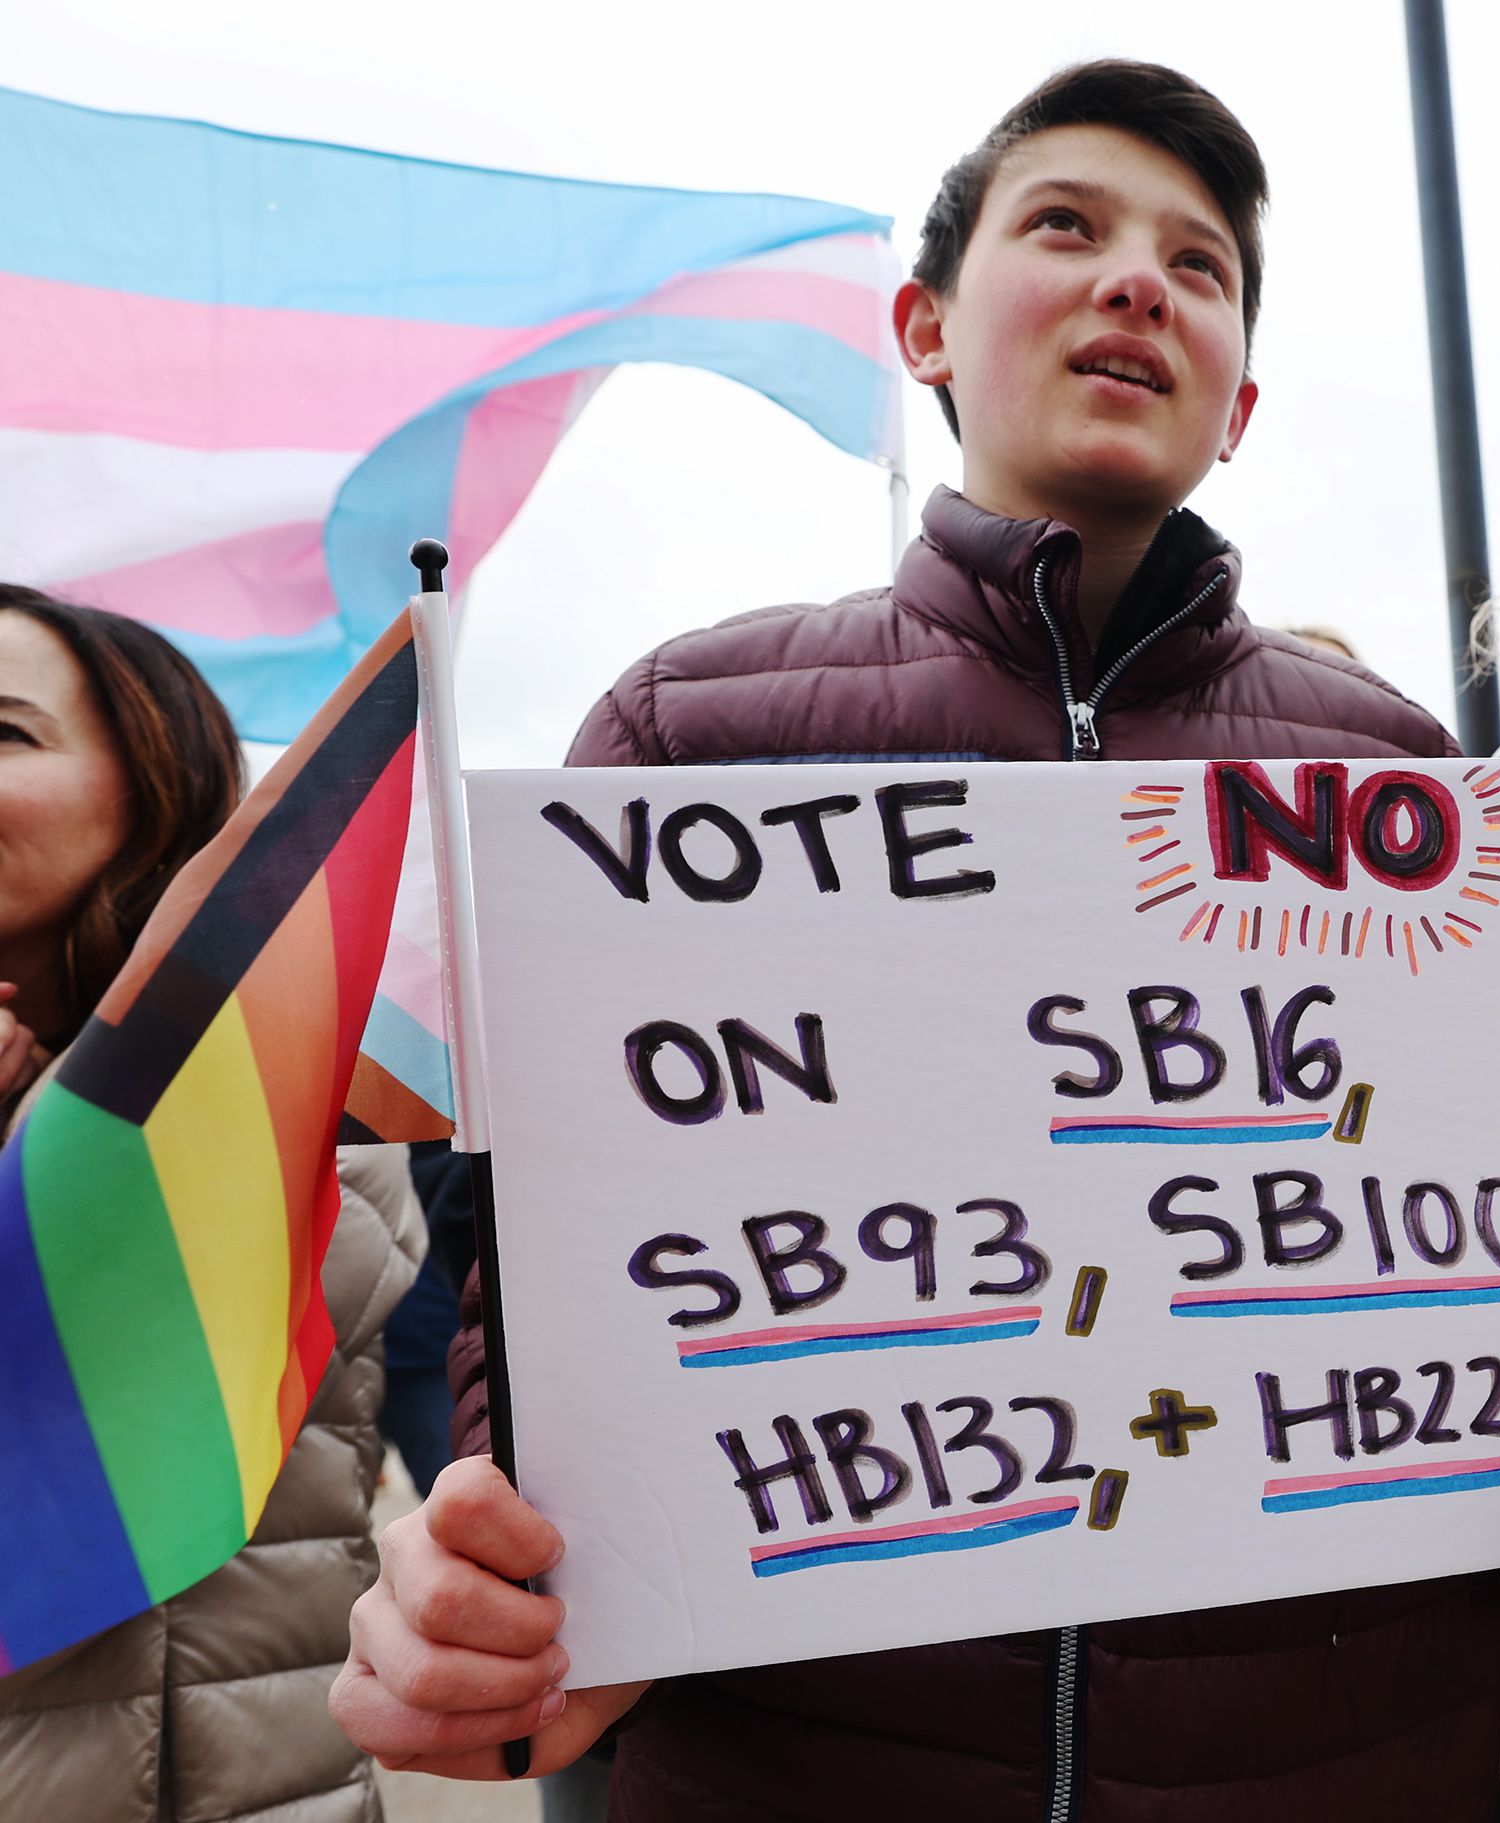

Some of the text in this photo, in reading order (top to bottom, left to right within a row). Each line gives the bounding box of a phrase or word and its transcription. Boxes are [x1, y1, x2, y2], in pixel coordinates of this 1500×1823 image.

[540, 761, 1462, 902] VOTE NO
[623, 983, 1375, 1145] ON SB16,
[627, 1196, 1108, 1338] SB93,
[715, 1395, 1130, 1534] HB132,
[1129, 1388, 1218, 1458] +
